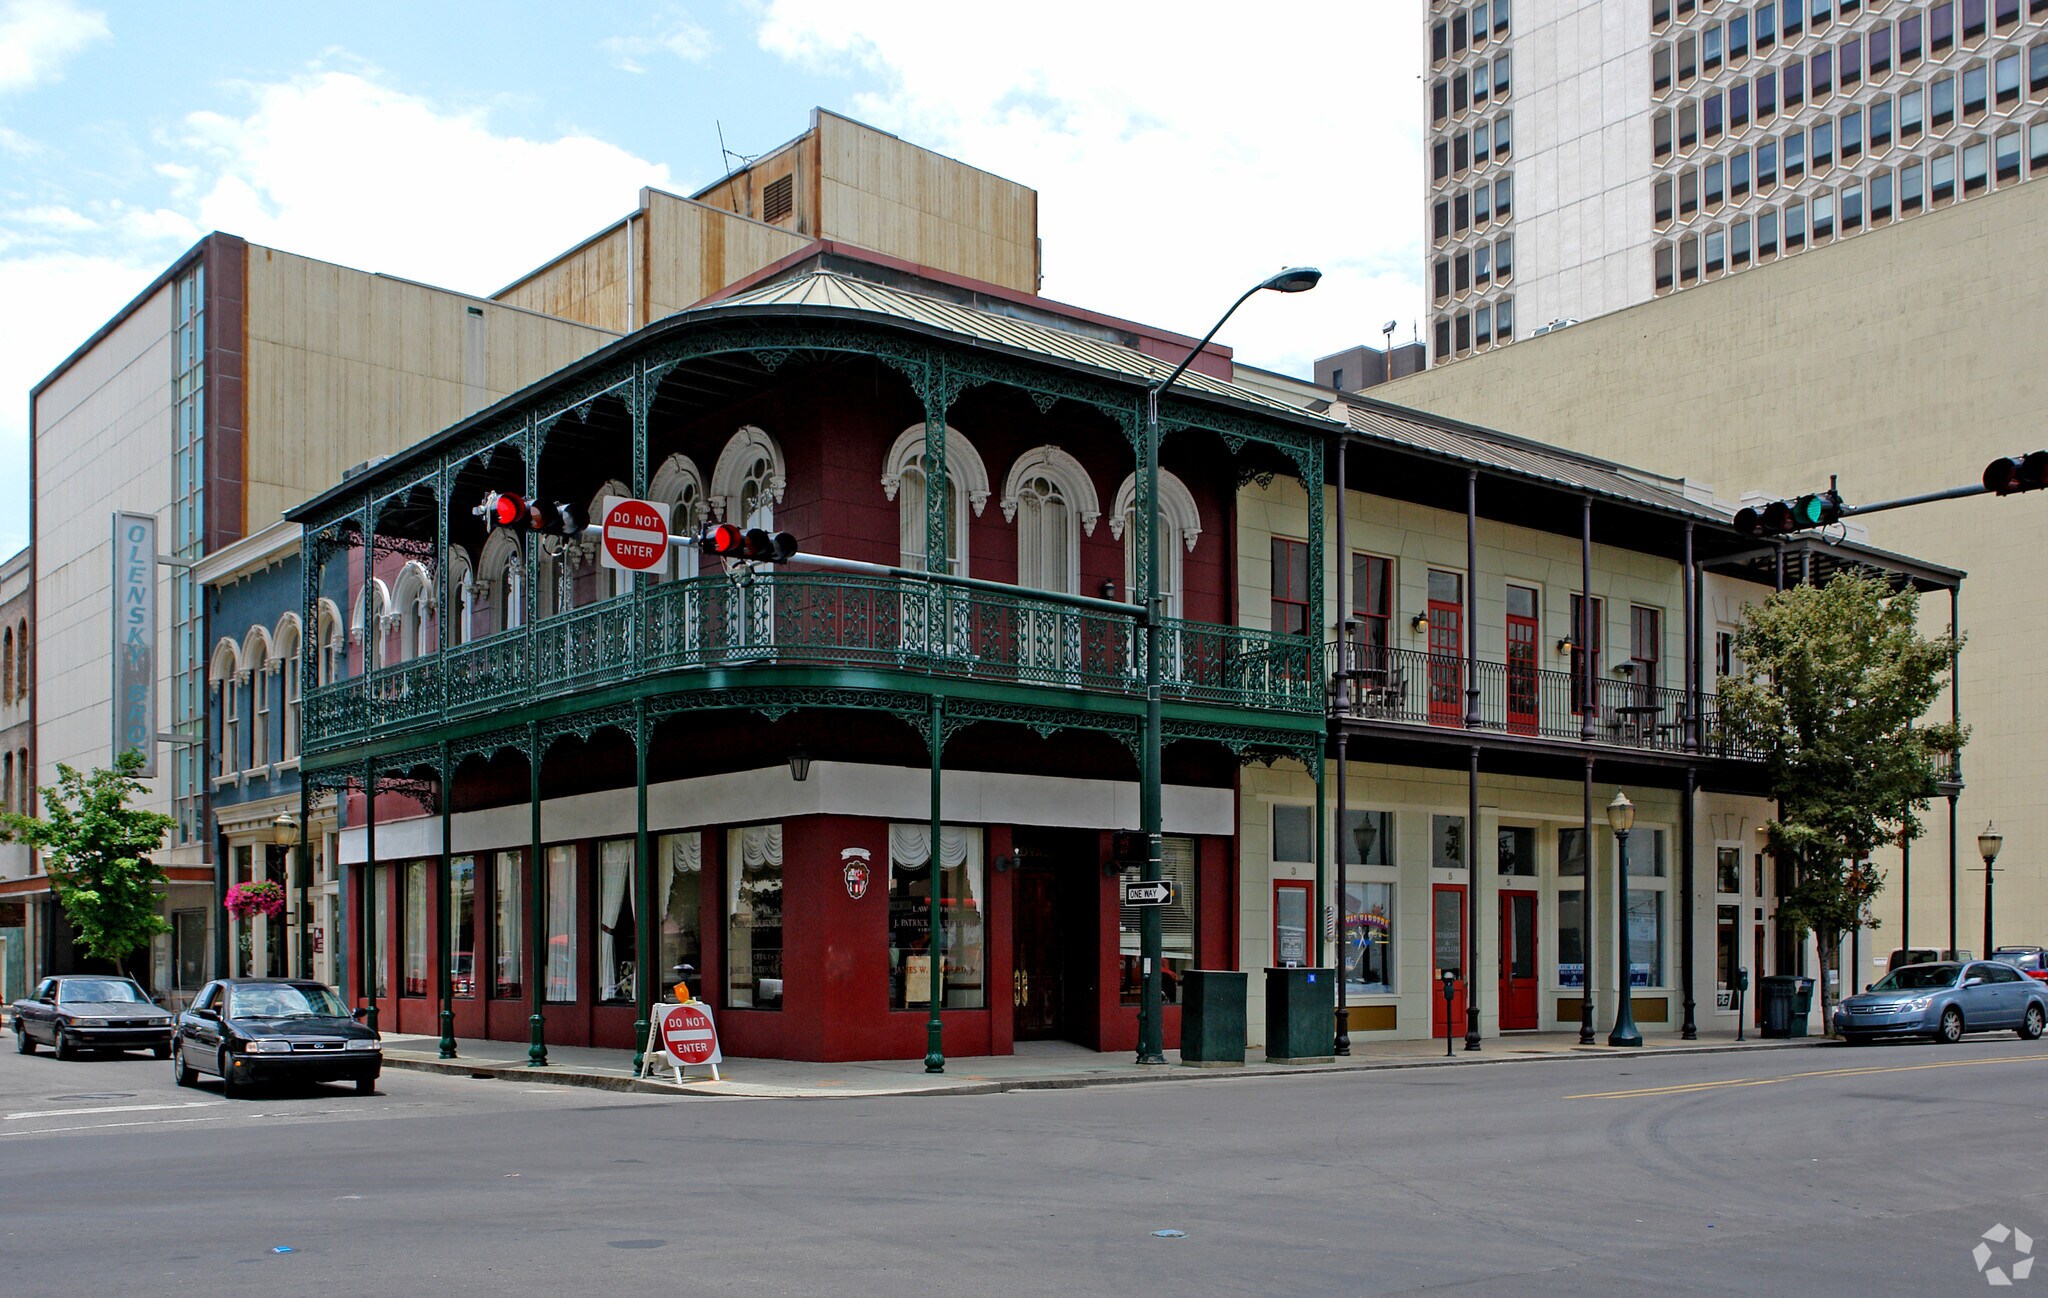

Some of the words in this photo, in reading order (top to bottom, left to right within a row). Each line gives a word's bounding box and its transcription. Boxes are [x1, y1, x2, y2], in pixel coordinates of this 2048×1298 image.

[614, 511, 630, 524] DO
[635, 514, 659, 528] NOT
[616, 543, 653, 558] ENTER
[126, 524, 147, 664] OLENSKY
[126, 684, 147, 751] BRO
[1291, 867, 1296, 875] 3
[1448, 872, 1453, 880] 5
[1130, 889, 1142, 898] ONE
[1143, 889, 1157, 898] WAY
[912, 905, 929, 913] LAW
[901, 919, 929, 927] PATRICK
[669, 1018, 682, 1028] DO
[686, 1017, 705, 1027] NOT
[677, 1042, 708, 1053] ENTER
